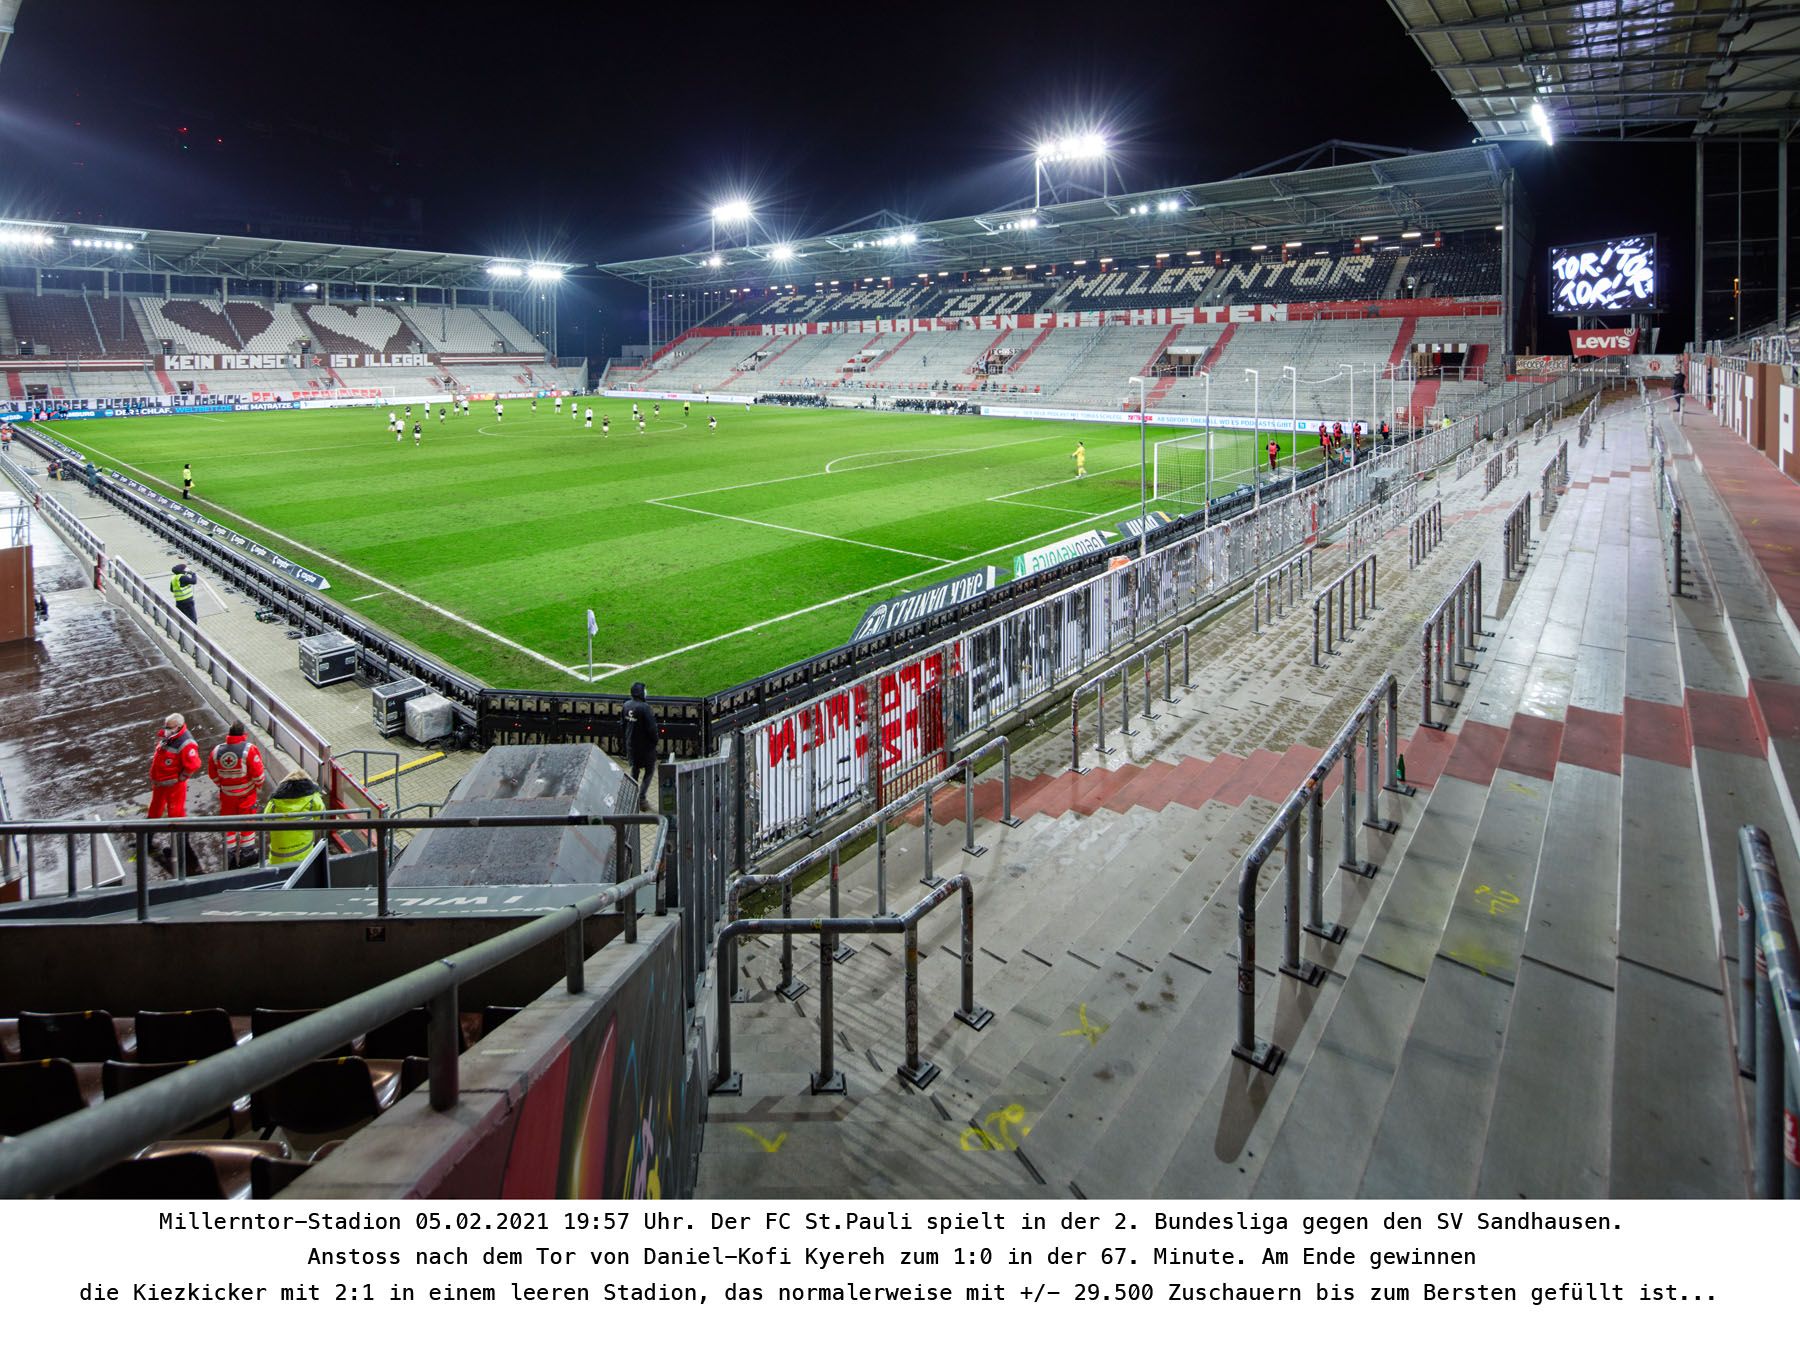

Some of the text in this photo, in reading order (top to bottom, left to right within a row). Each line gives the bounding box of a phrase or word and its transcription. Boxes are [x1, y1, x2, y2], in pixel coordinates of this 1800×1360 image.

[936, 291, 1032, 317] 1910
[762, 323, 807, 336] KEIN
[816, 317, 945, 335] FUSSBALL
[1033, 303, 1287, 329] FASCHISTEN
[165, 354, 301, 370] KEIN MENSCH
[331, 353, 434, 368] IST ILLEGAL
[175, 405, 232, 413] WELTBETT.DE
[250, 403, 293, 411] MATRATZE.
[950, 573, 983, 605] JACK
